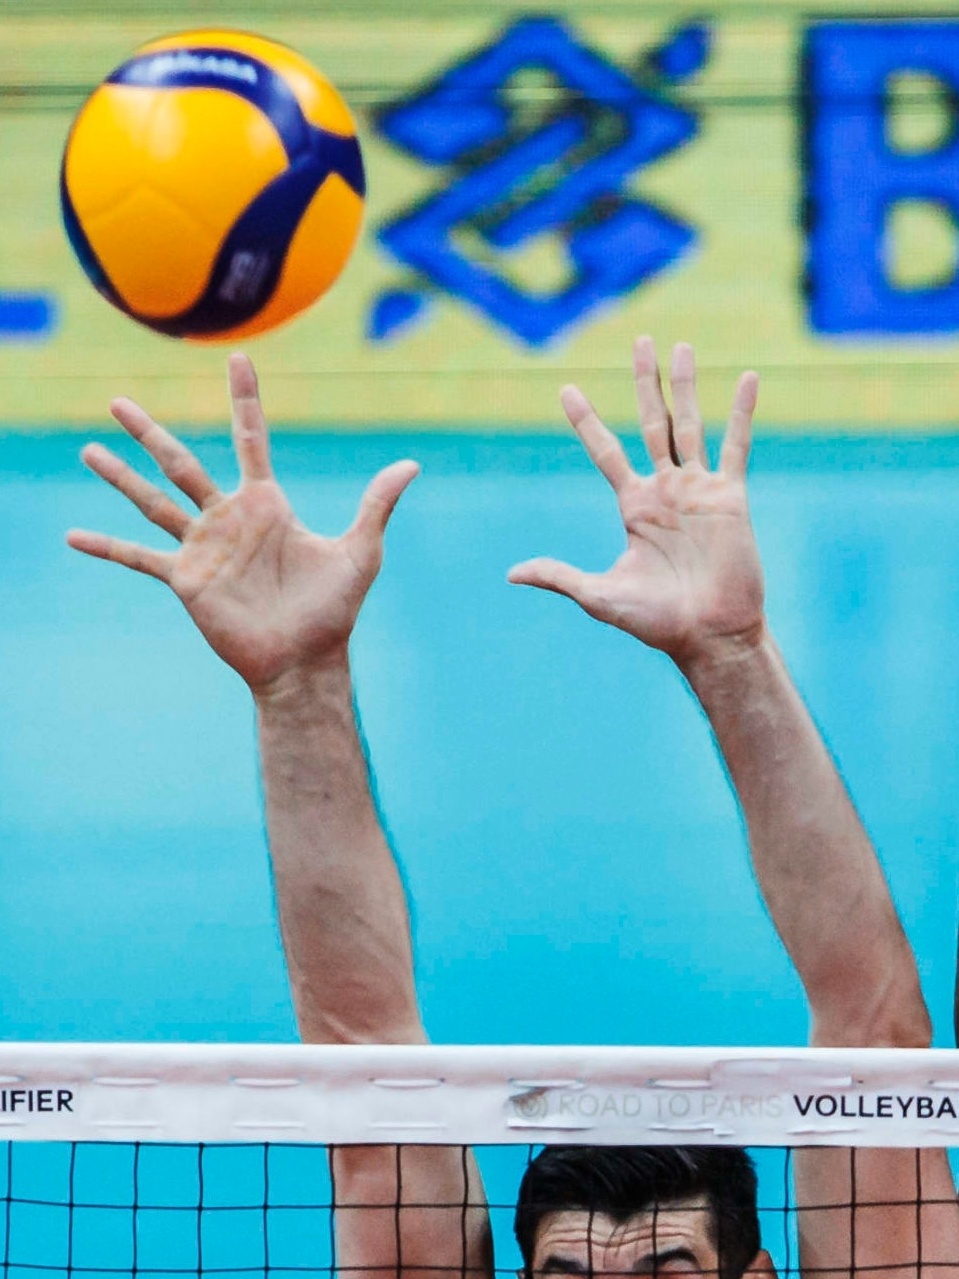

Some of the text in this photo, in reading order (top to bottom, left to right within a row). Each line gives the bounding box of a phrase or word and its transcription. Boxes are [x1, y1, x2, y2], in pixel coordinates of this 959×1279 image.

[558, 1094, 641, 1118] ROAD
[652, 1094, 690, 1118] TO
[701, 1094, 784, 1119] PARIS
